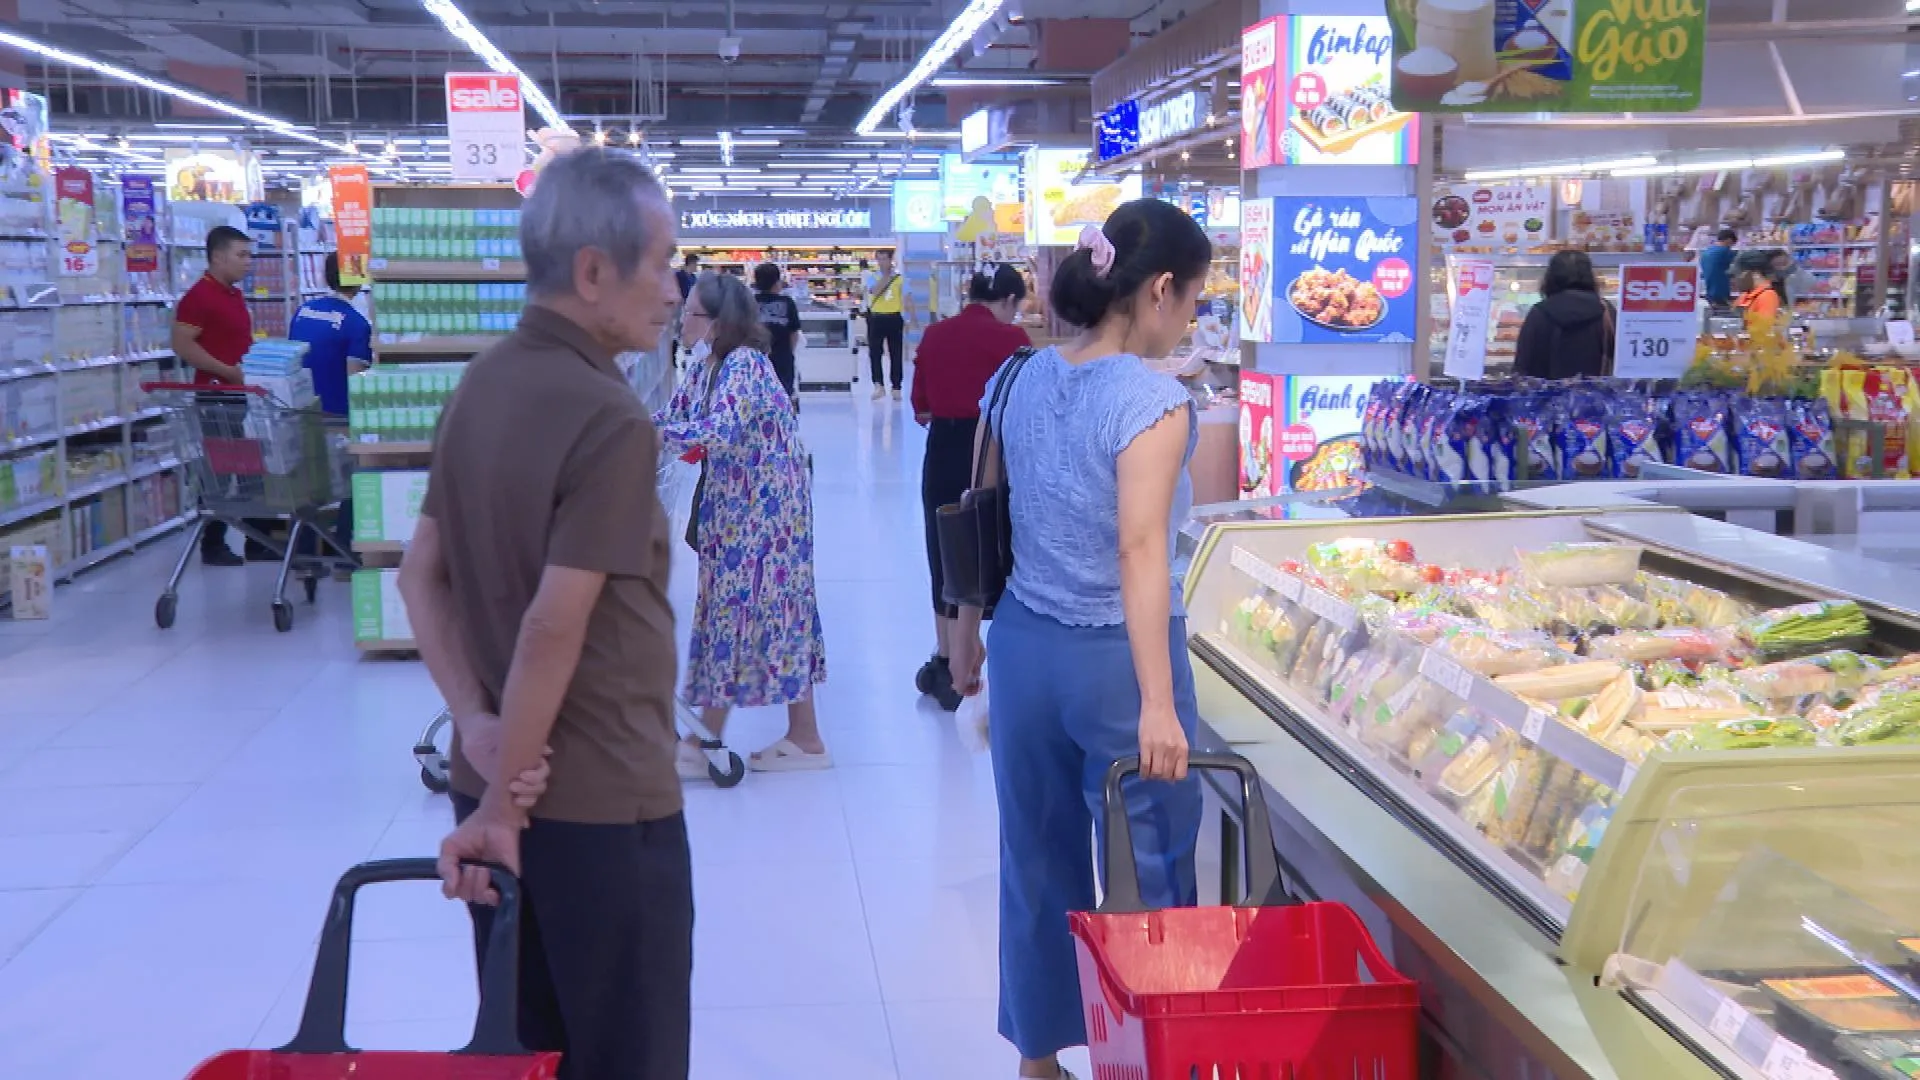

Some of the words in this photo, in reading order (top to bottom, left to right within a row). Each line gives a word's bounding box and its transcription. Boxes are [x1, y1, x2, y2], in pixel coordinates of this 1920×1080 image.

[452, 79, 518, 107] sale
[466, 143, 498, 165] 33
[1626, 270, 1694, 300] sale
[1629, 337, 1669, 357] 130
